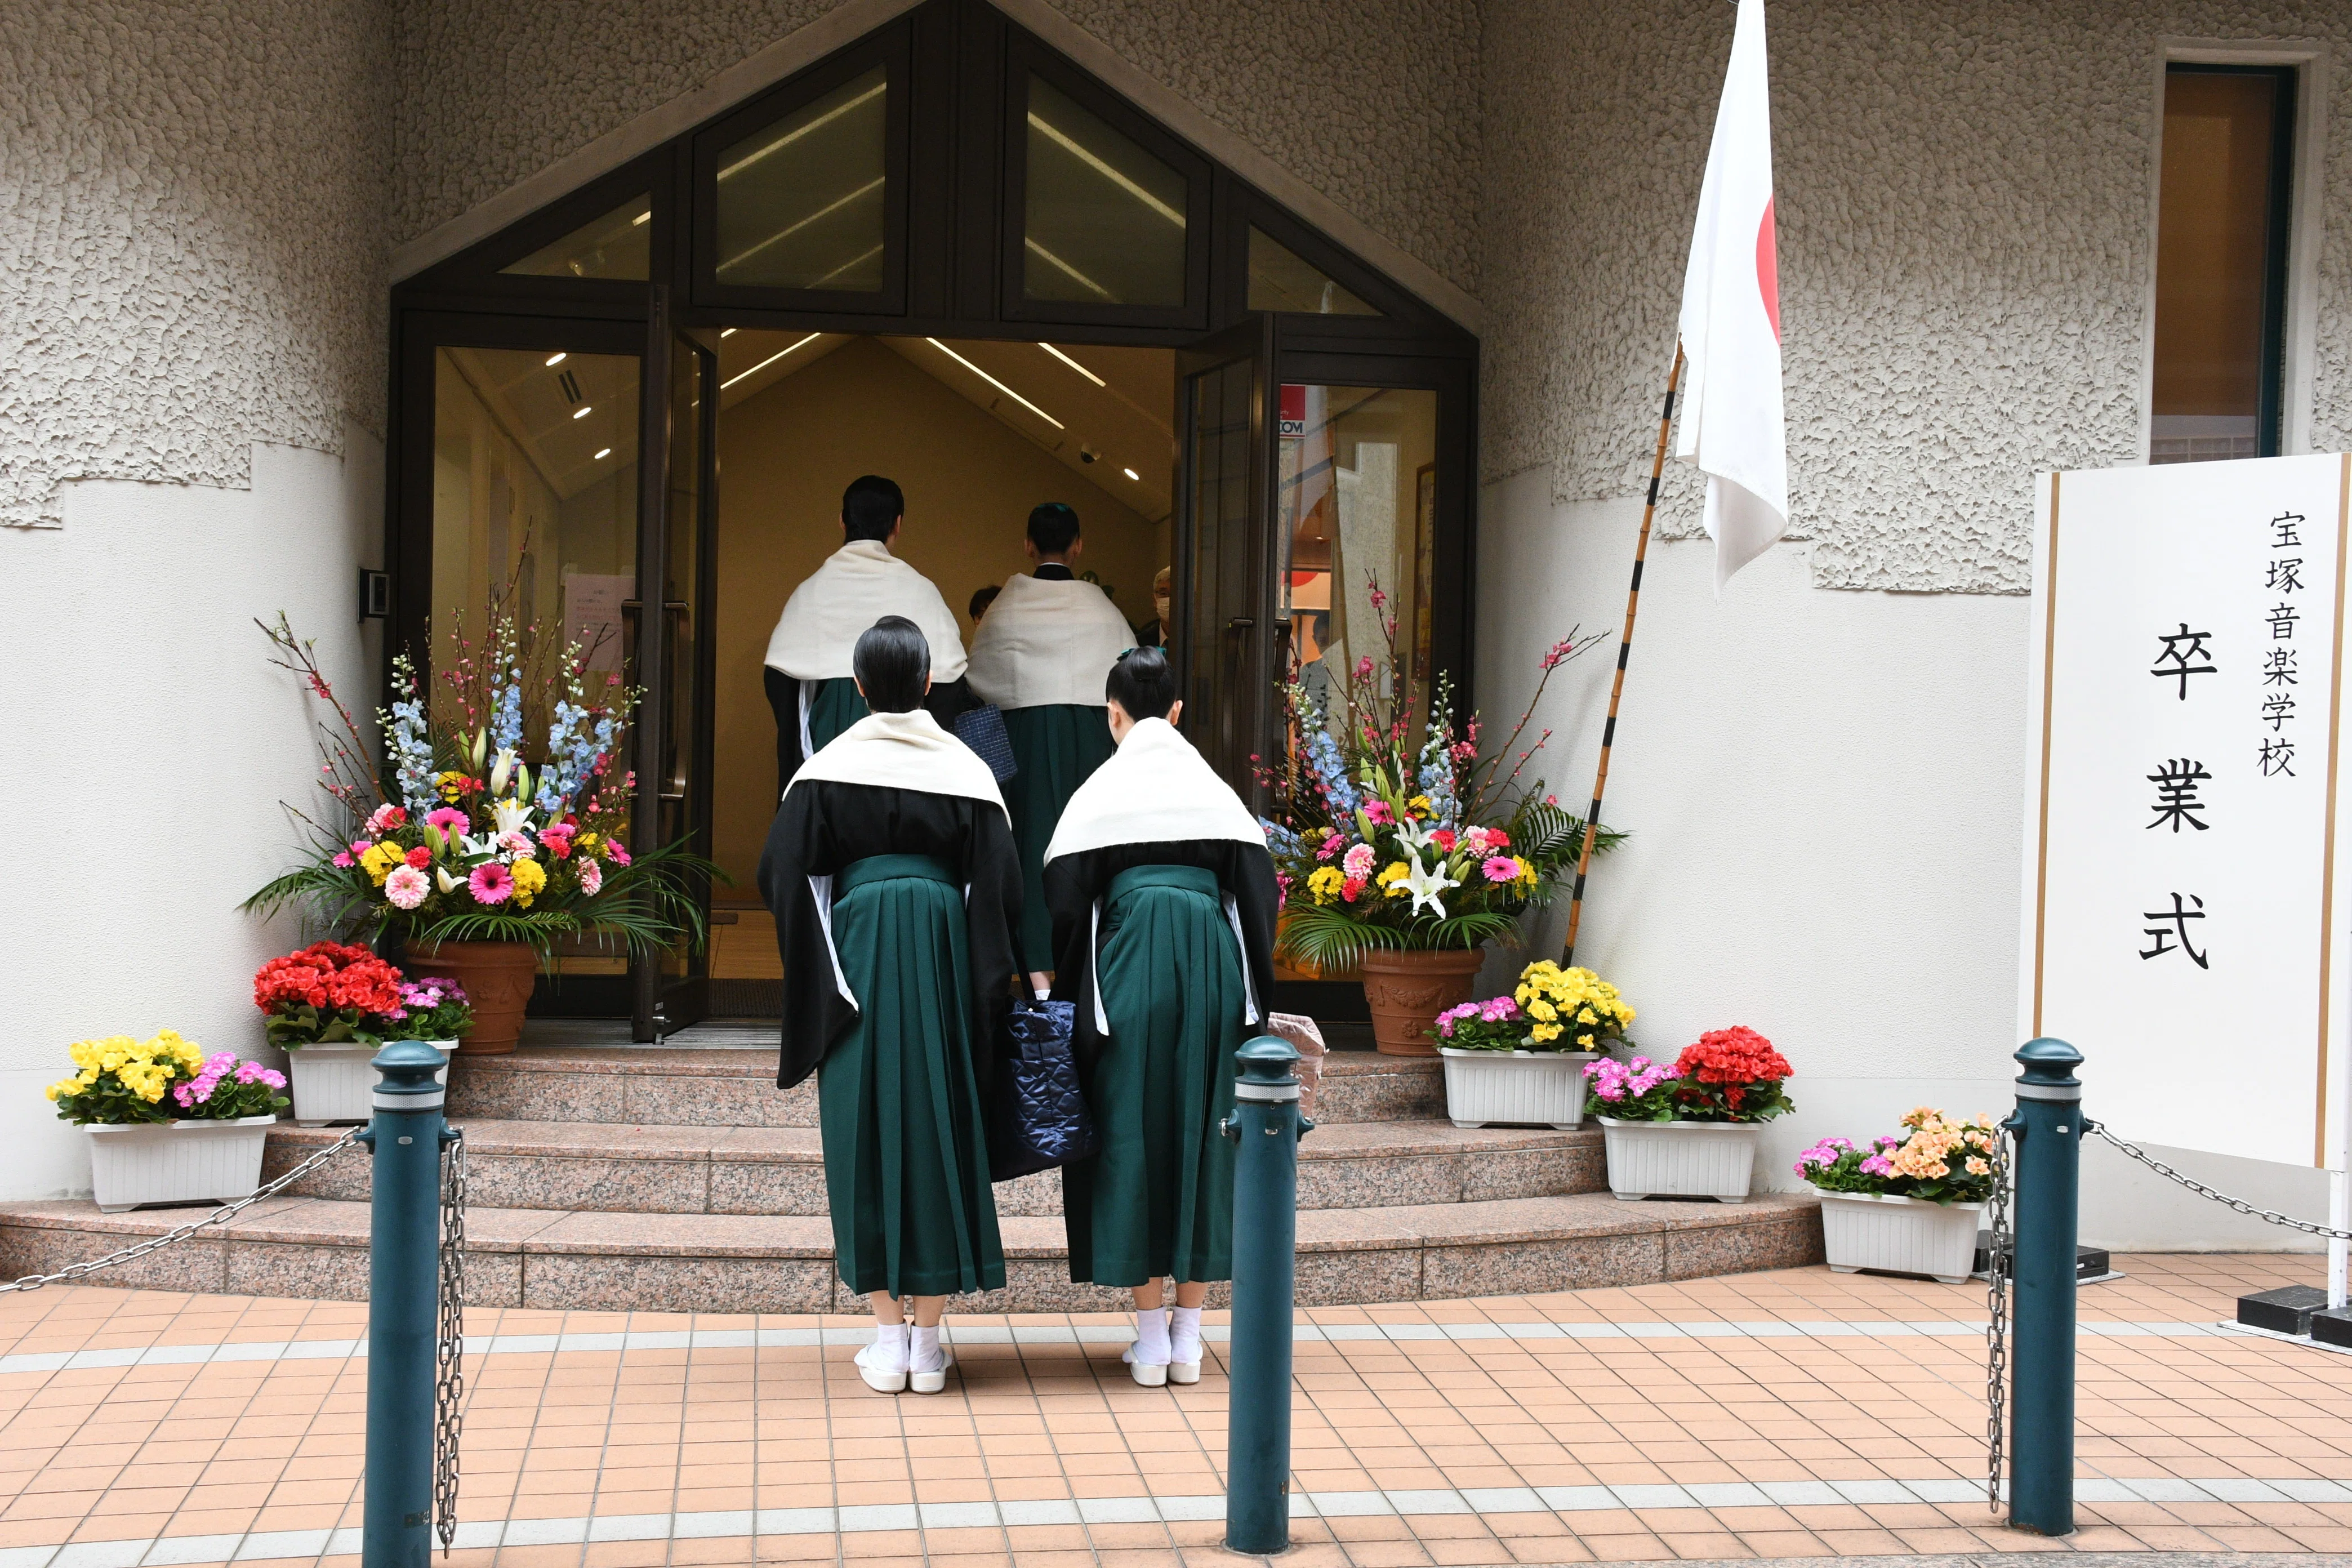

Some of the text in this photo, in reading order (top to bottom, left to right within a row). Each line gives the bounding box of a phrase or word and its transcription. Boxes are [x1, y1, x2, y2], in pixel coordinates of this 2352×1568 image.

[2139, 623, 2218, 970] 卒業式
[2257, 510, 2306, 777] 宝塚音楽学校
